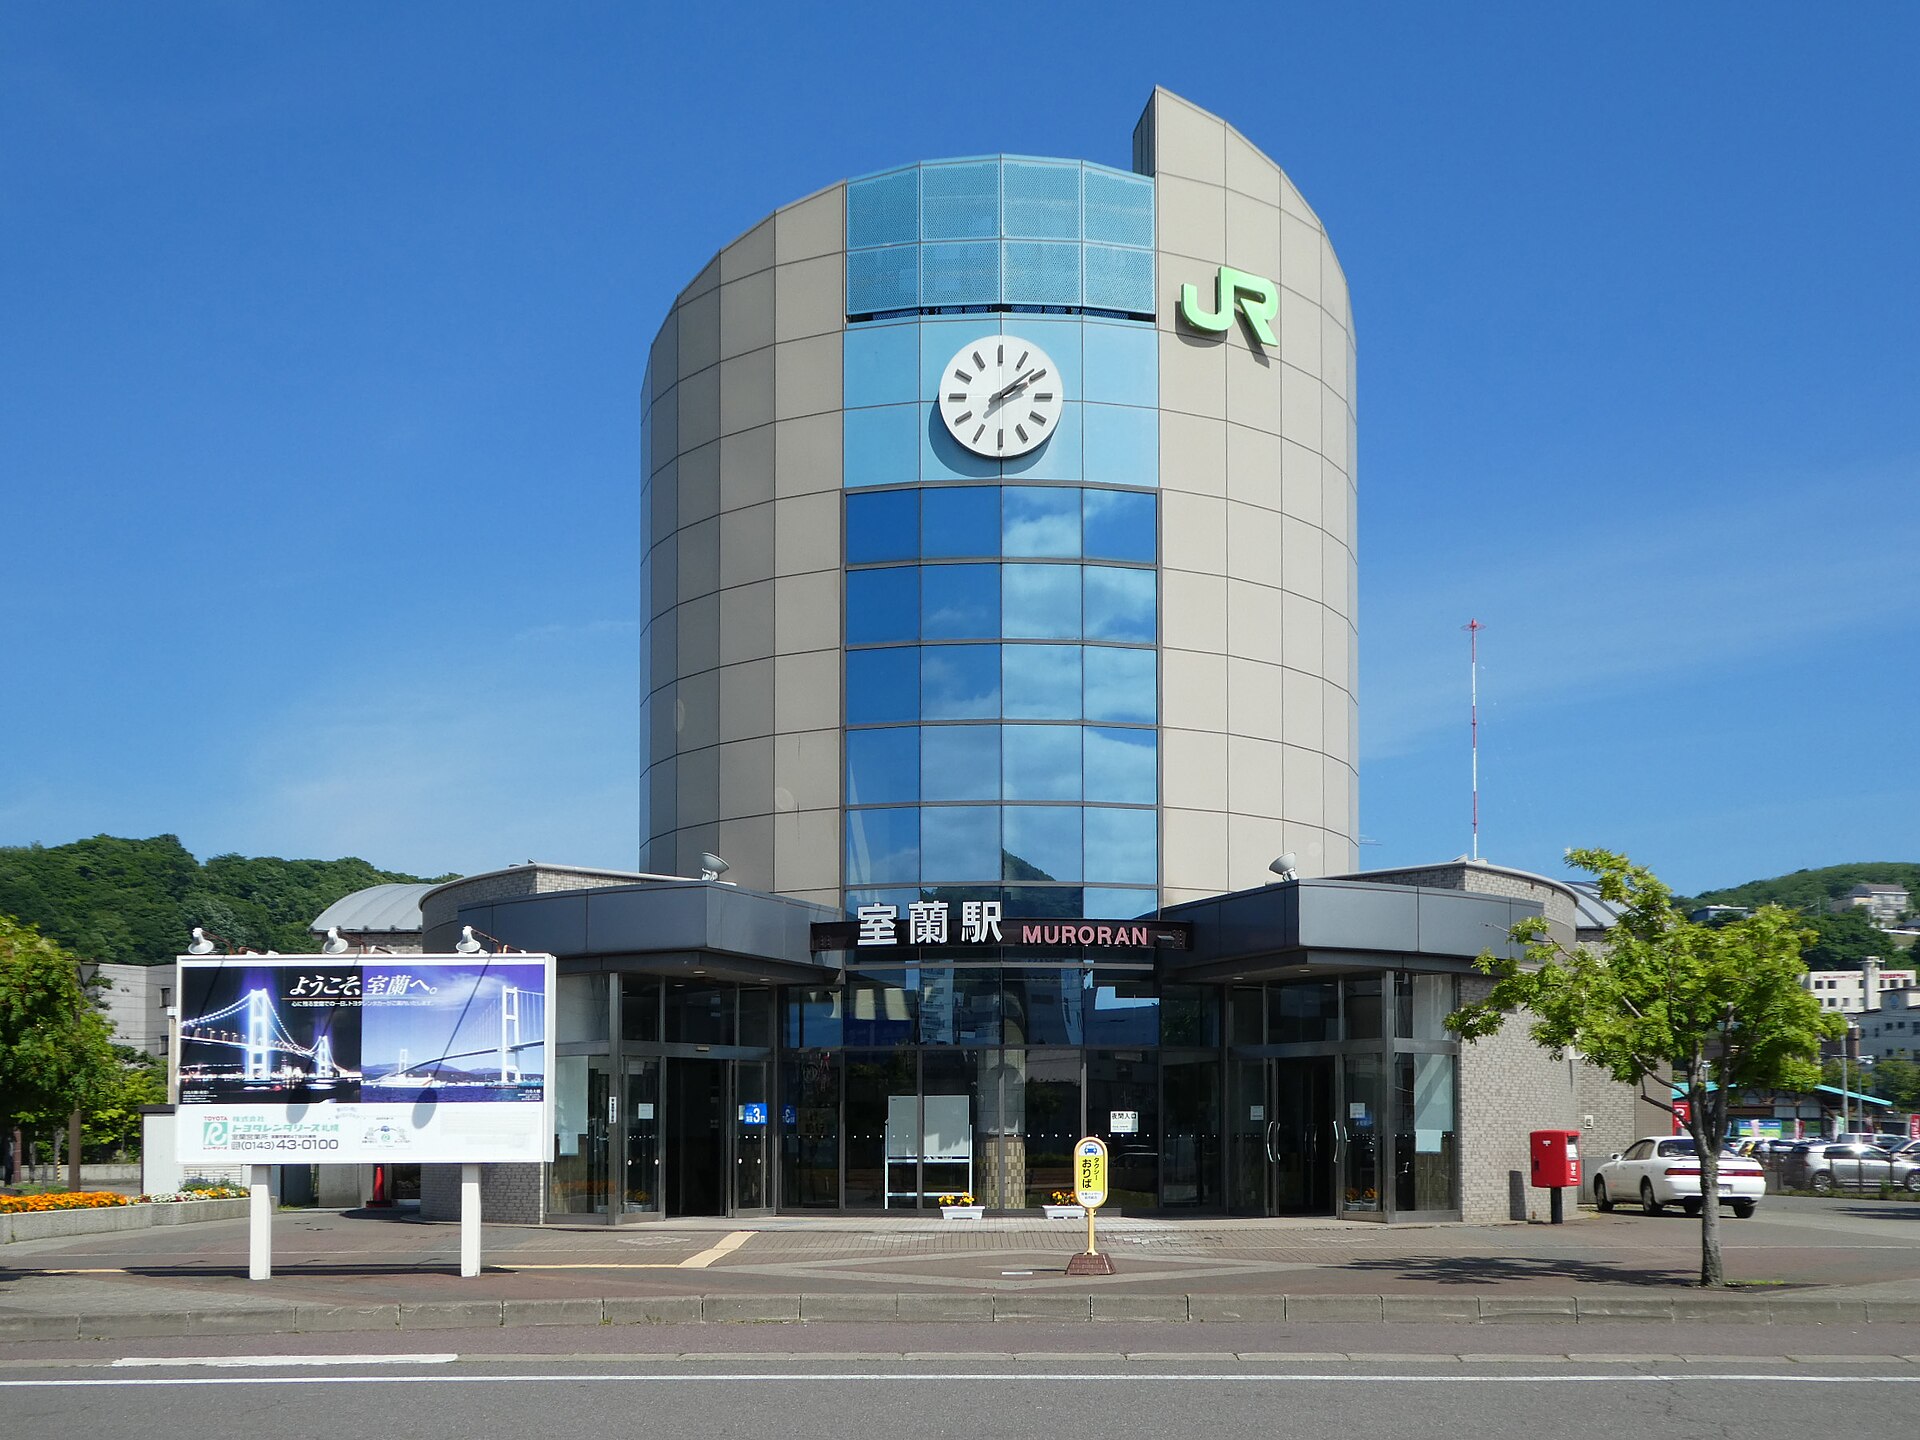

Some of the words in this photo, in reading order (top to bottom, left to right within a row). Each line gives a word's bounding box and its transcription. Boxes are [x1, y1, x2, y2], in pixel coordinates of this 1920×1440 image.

[1181, 266, 1278, 347] JR
[857, 901, 1002, 945] 室蘭駅
[1022, 925, 1147, 945] MURORAN
[1082, 1159, 1092, 1188] おりば
